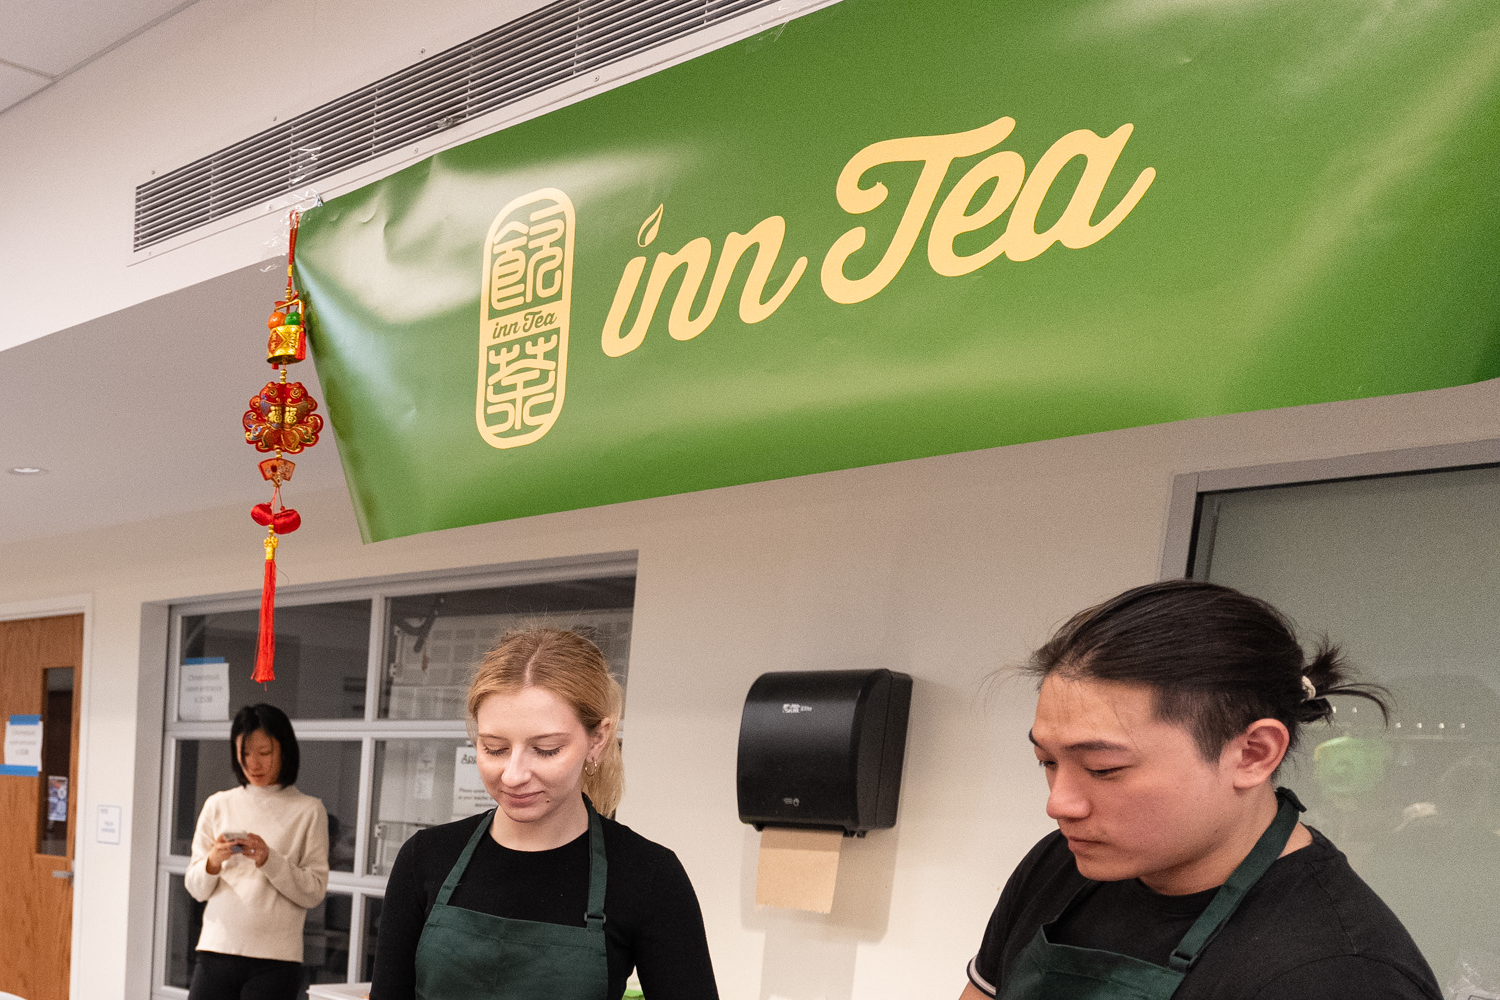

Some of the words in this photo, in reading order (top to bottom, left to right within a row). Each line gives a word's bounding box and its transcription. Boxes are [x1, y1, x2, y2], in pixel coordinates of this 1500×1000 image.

[601, 203, 808, 358] inn
[820, 115, 1156, 305] Tea
[492, 322, 521, 340] inn
[522, 309, 558, 333] Tea
